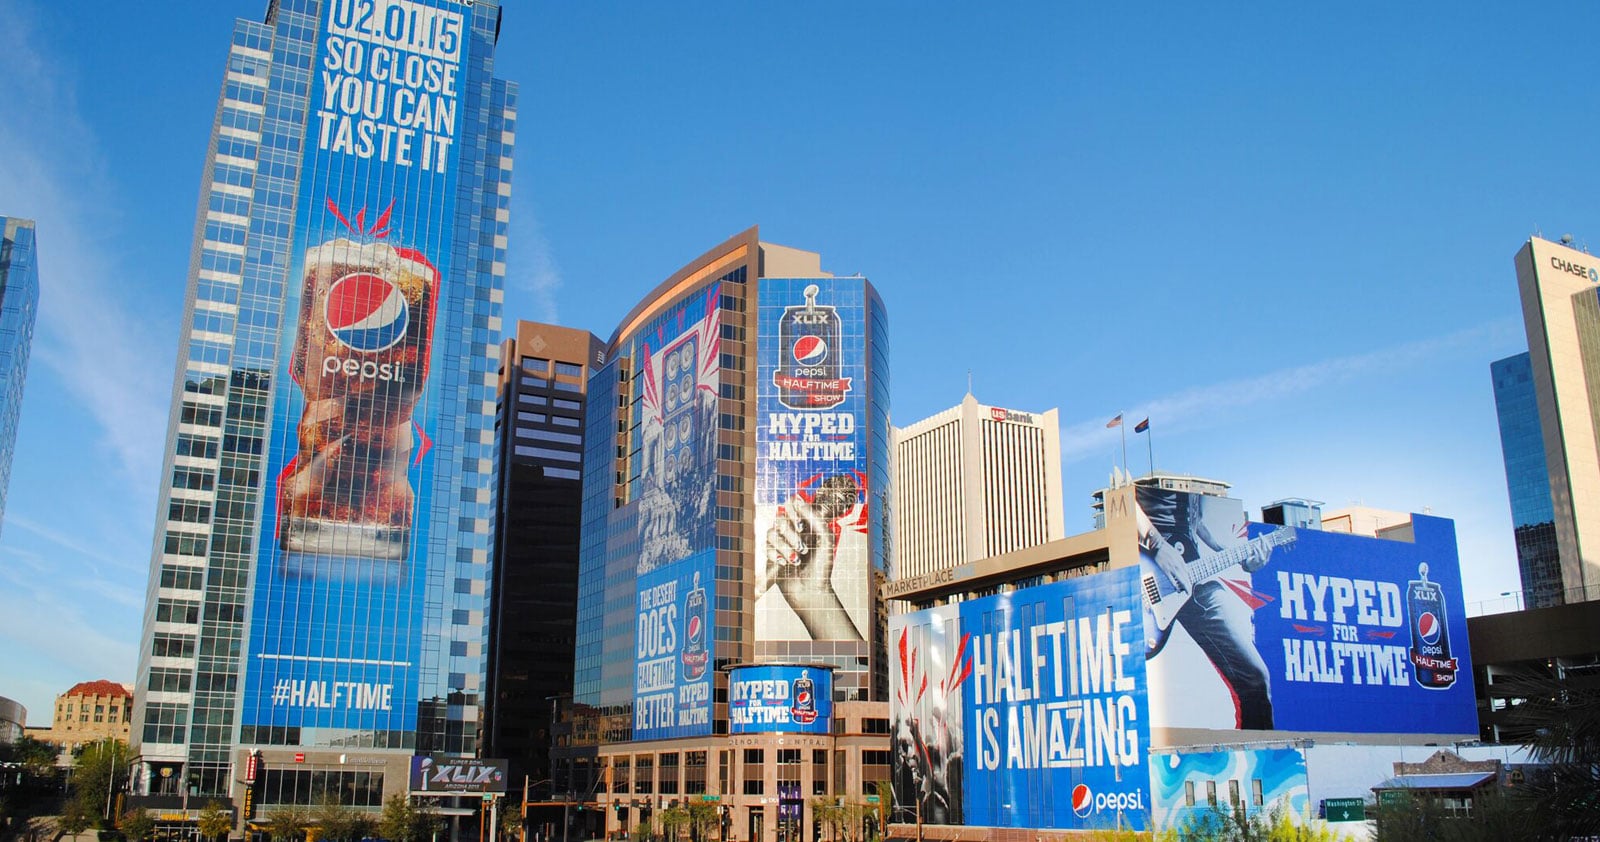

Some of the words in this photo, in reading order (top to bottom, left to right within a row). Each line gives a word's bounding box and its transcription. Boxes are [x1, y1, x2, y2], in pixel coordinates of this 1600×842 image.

[324, 36, 363, 74] SO
[370, 47, 459, 96] CLOSE
[322, 71, 389, 120] YOU
[393, 85, 456, 136] CAN
[317, 110, 414, 167] TASTE
[421, 133, 453, 173] IT
[1551, 257, 1588, 279] CHASE
[791, 314, 829, 325] XLIX
[322, 356, 401, 383] pepsi
[795, 366, 826, 378] pepsi
[783, 378, 840, 390] HALFTIME
[814, 394, 841, 402] SHOW
[769, 413, 854, 435] HYPED
[803, 433, 820, 442] FOR
[768, 441, 854, 461] HALFTIME
[640, 588, 652, 611] THE
[652, 579, 678, 606] DESERT
[1276, 570, 1403, 627] HYPED
[1413, 590, 1438, 602] XLIX
[638, 603, 677, 659] DOES
[1332, 624, 1359, 642] FOR
[973, 610, 1135, 704] HALFTIME
[1422, 645, 1442, 656] pepsi
[1283, 638, 1410, 687] HALFTIME
[1415, 655, 1452, 669] HALFTIME
[637, 657, 675, 691] HALFTIME
[1437, 674, 1453, 682] SHOW
[271, 678, 394, 711] #HALFTIME
[679, 681, 709, 705] HYPED
[733, 680, 789, 701] HYPED
[636, 692, 674, 731] BETTER
[749, 699, 762, 707] FOR
[678, 706, 709, 727] HALFTIME
[732, 706, 790, 725] HALFTIME
[976, 707, 1000, 771] IS
[1006, 695, 1139, 769] AMAZING
[430, 765, 497, 783] XLIX
[1096, 788, 1141, 813] pepsi
